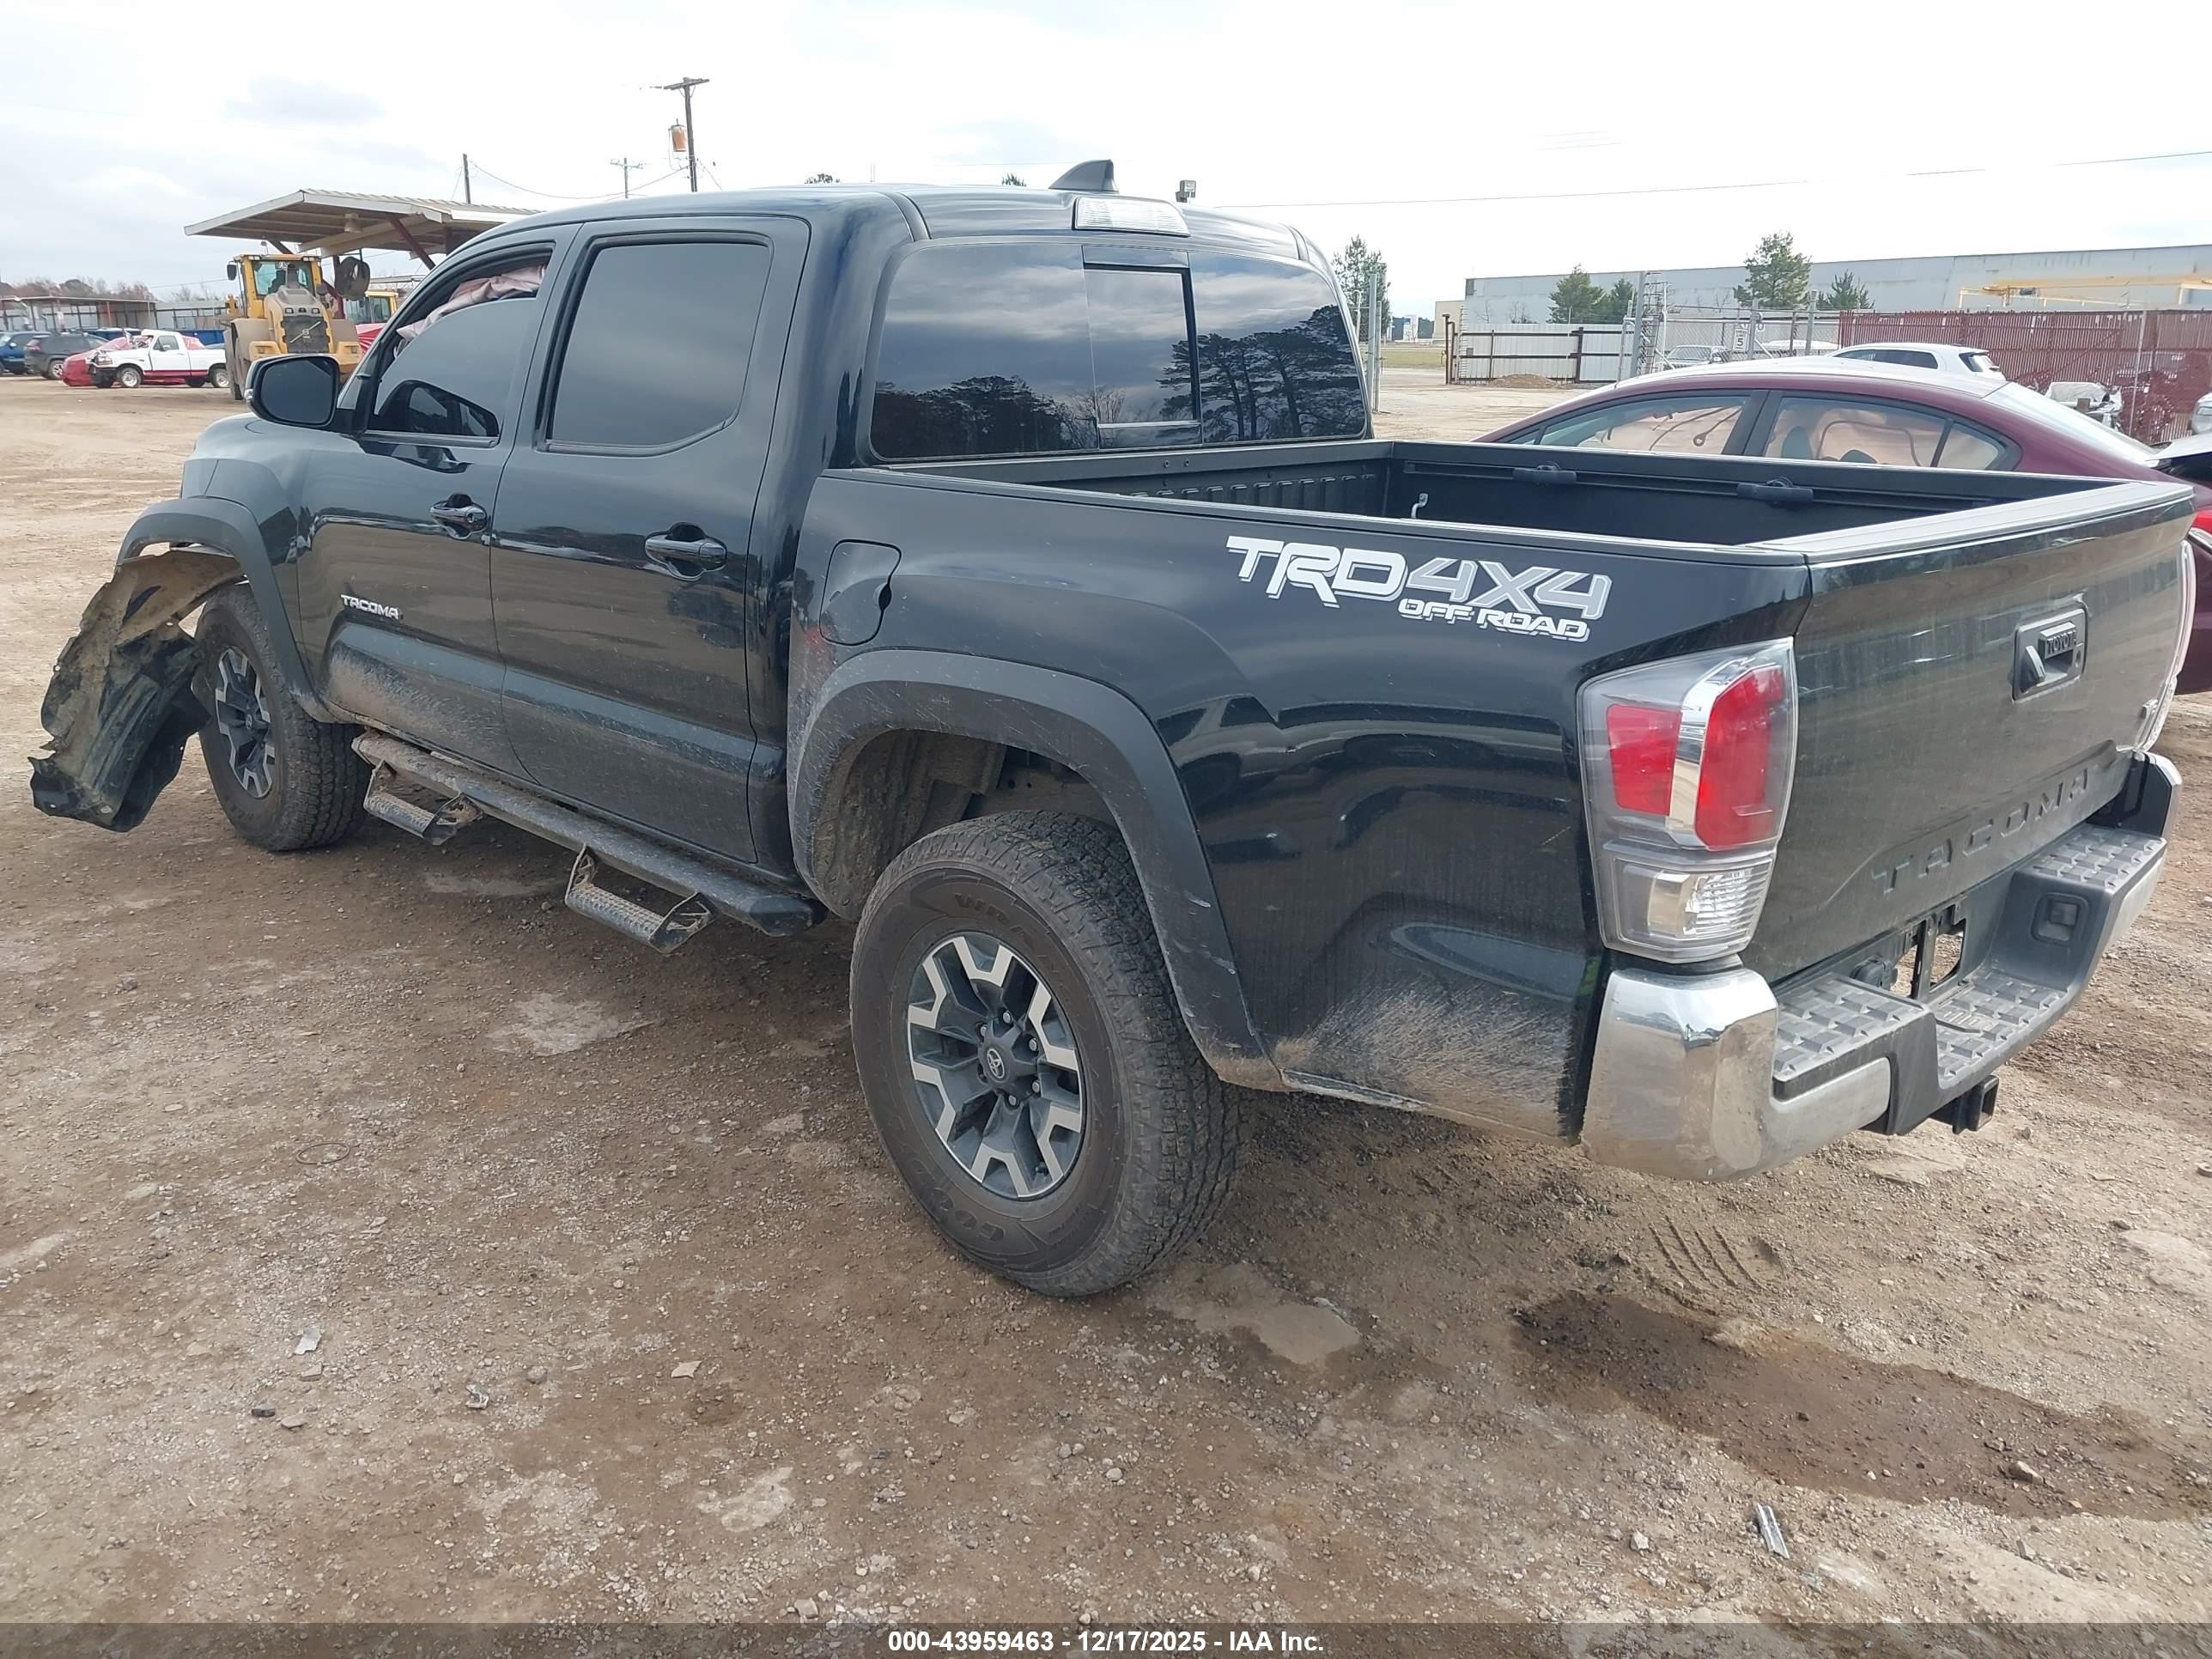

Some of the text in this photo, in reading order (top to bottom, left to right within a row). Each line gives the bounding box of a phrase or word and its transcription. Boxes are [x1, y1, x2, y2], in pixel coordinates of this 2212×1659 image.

[340, 593, 399, 620] TACOMA
[1226, 535, 1613, 620] TRD 4X4
[1398, 599, 1590, 642] OFF ROAD
[1871, 768, 2088, 894] TACOMA
